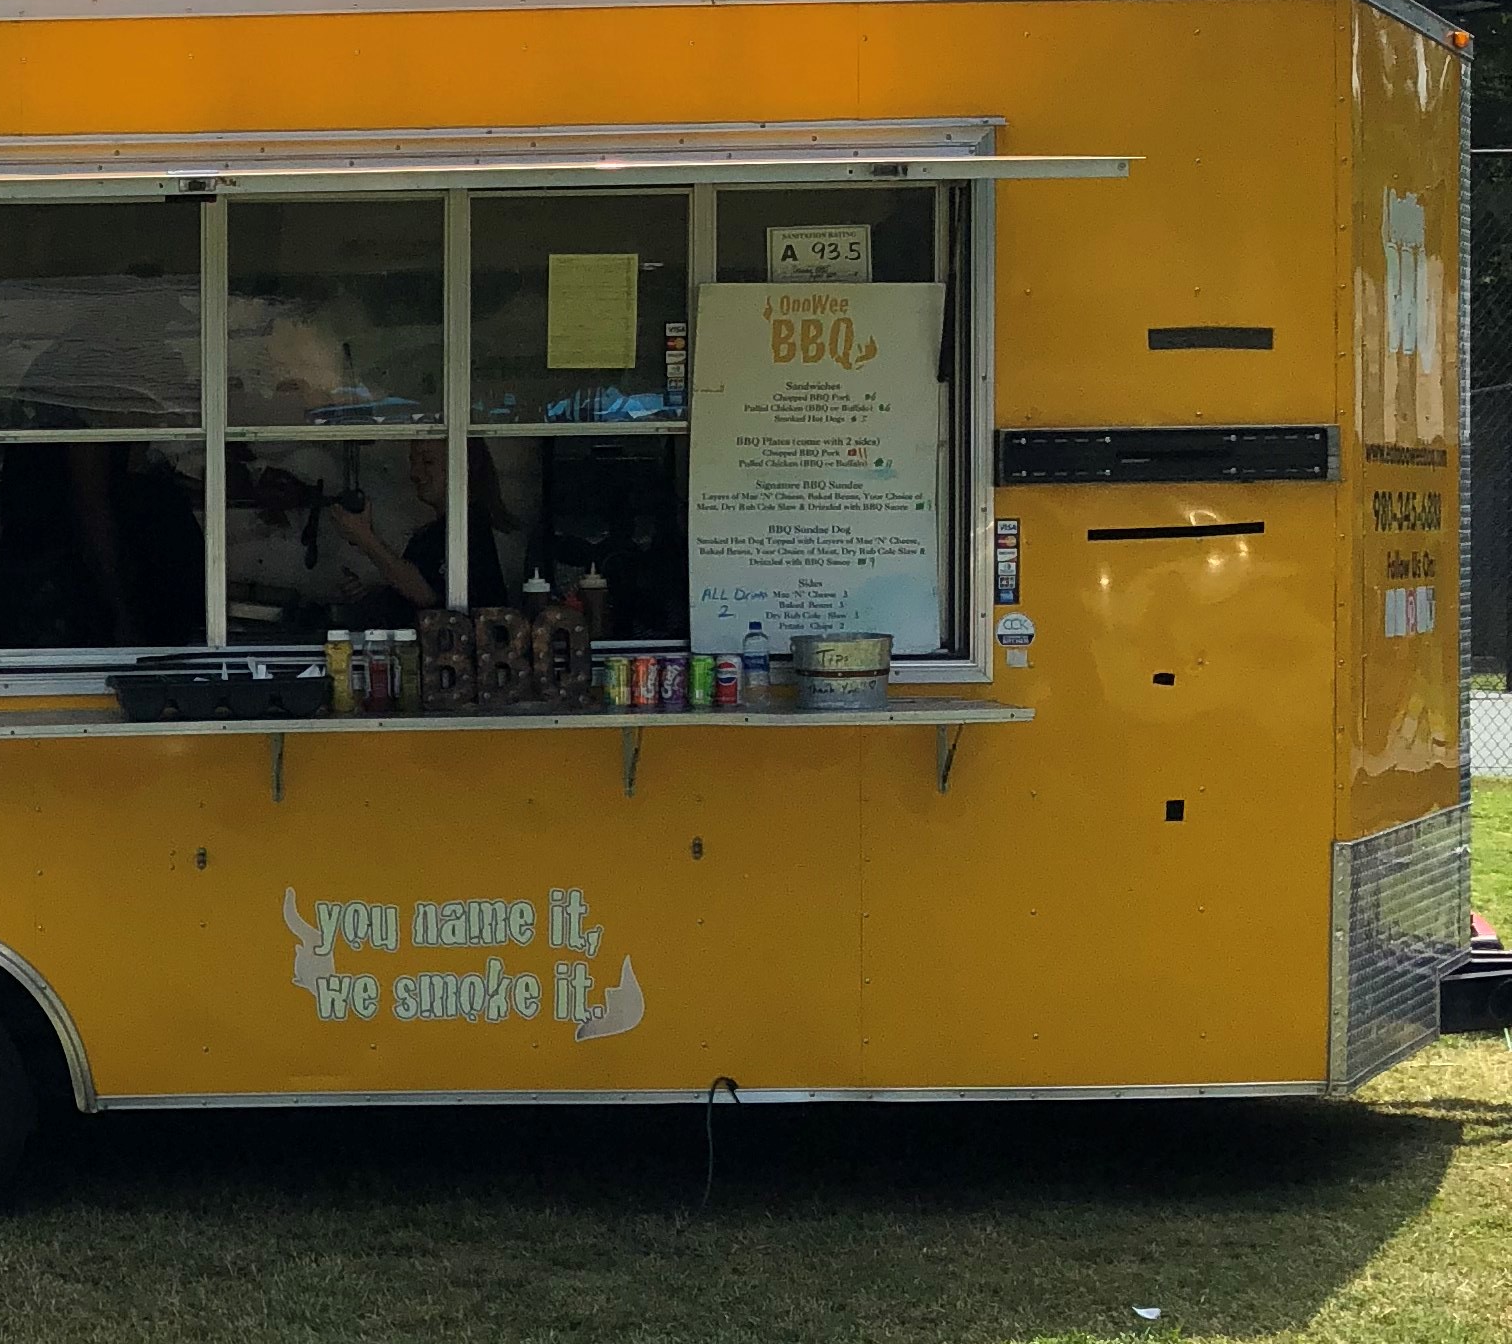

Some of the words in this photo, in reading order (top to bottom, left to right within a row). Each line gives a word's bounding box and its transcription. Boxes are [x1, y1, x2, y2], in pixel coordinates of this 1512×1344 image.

[782, 232, 826, 241] SANITATION
[828, 230, 857, 238] RATING
[781, 244, 799, 262] A
[771, 317, 855, 371] BBQ
[786, 382, 841, 392] Sandwiches
[772, 393, 808, 403] Chopped
[809, 393, 830, 403] BBQ
[832, 393, 850, 403] Pork
[744, 404, 769, 413] Pulled
[770, 404, 804, 413] Chicken
[805, 404, 829, 413] (BBQ
[774, 415, 806, 424] Smoked
[807, 415, 823, 424] Hot
[825, 415, 845, 424] Dogs
[736, 437, 760, 447] BBQ
[762, 437, 790, 447] Plates
[792, 437, 821, 447] (come
[823, 437, 844, 447] with
[846, 437, 852, 447] 2
[855, 437, 881, 447] sides)
[762, 449, 798, 459] Chopped
[799, 449, 820, 459] BBQ
[821, 449, 840, 459] Pork
[738, 459, 764, 469] Pulled
[765, 459, 799, 469] Chicken
[800, 459, 824, 469] (BBQ
[755, 480, 801, 490] Signature
[803, 480, 827, 490] BBQ
[829, 480, 863, 490] Sundae
[702, 492, 730, 501] Layers
[742, 492, 758, 501] Mac
[808, 492, 833, 501] Baked
[863, 492, 884, 501] Your
[886, 492, 913, 501] Choice
[721, 503, 736, 511] Dry
[844, 503, 861, 511] with
[863, 503, 883, 511] BBQ
[768, 525, 792, 535] BBQ
[794, 525, 829, 535] Sundae
[831, 525, 852, 535] Dog
[999, 523, 1017, 531] VISA
[696, 537, 729, 545] Smoked
[730, 537, 746, 545] Hot
[748, 537, 764, 545] Dog
[766, 537, 796, 545] Topped
[797, 537, 815, 545] with
[817, 537, 844, 545] Layers
[856, 537, 873, 545] Mac
[700, 547, 724, 556] Baked
[755, 547, 776, 556] Your
[777, 547, 805, 556] Choice
[841, 547, 857, 556] Dry
[859, 547, 876, 556] Rub
[877, 547, 896, 556] Cole
[898, 547, 918, 556] Slaw
[785, 558, 803, 567] with
[804, 558, 825, 567] BBQ
[798, 578, 823, 588] Sides
[701, 587, 728, 602] ALL
[808, 590, 837, 598] Cheese
[779, 600, 805, 608] Baked
[809, 600, 833, 608] Beans
[717, 605, 735, 618] 2
[765, 611, 781, 620] Dry
[784, 611, 801, 620] Rub
[802, 611, 821, 620] Cole
[779, 622, 804, 631] Potato
[810, 622, 833, 631] Chips
[420, 607, 589, 706] BBQ
[313, 899, 399, 955] you
[412, 899, 536, 947] name
[549, 888, 603, 957] it,
[315, 972, 380, 1021] we
[393, 957, 541, 1023] smoke
[554, 961, 604, 1024] it.
